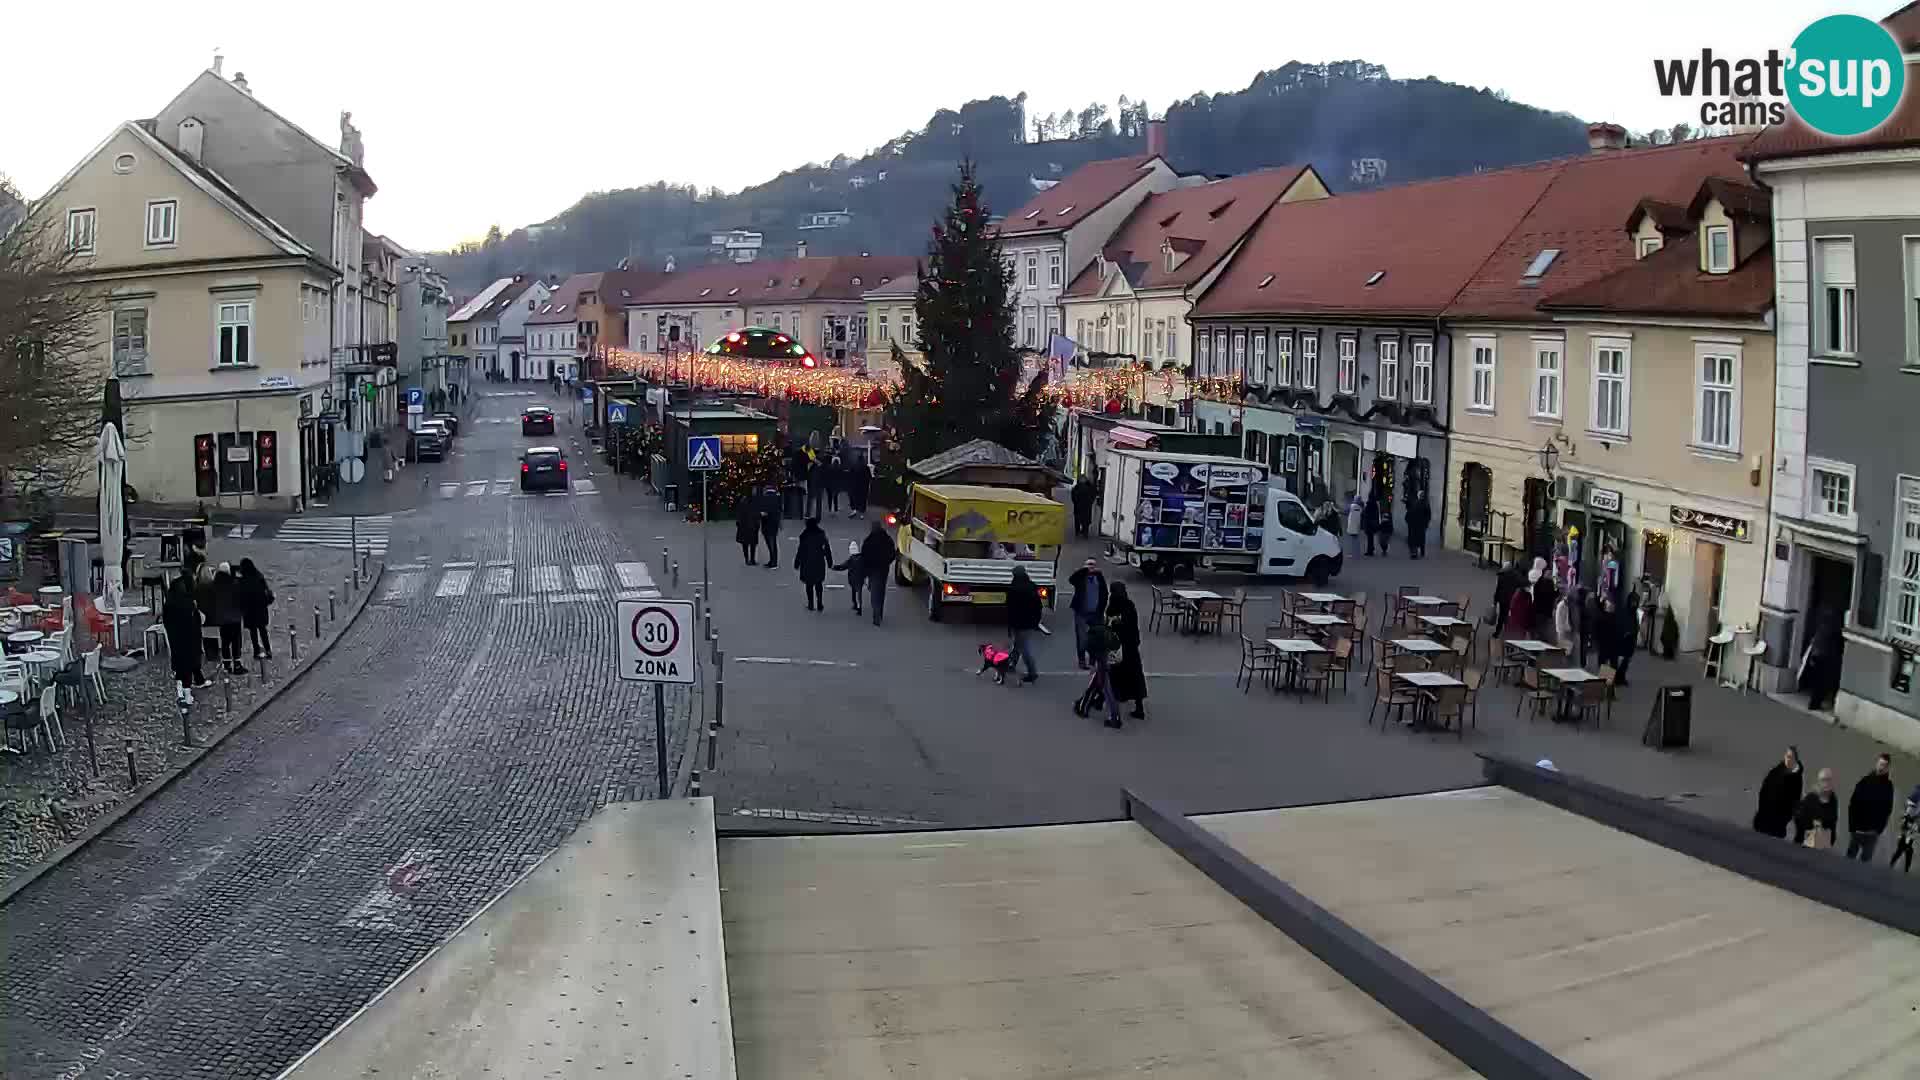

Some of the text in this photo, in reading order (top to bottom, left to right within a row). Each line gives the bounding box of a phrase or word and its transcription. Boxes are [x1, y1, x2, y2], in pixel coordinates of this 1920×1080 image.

[411, 391, 420, 402] P
[644, 622, 668, 643] 30
[634, 660, 679, 676] ZONA
